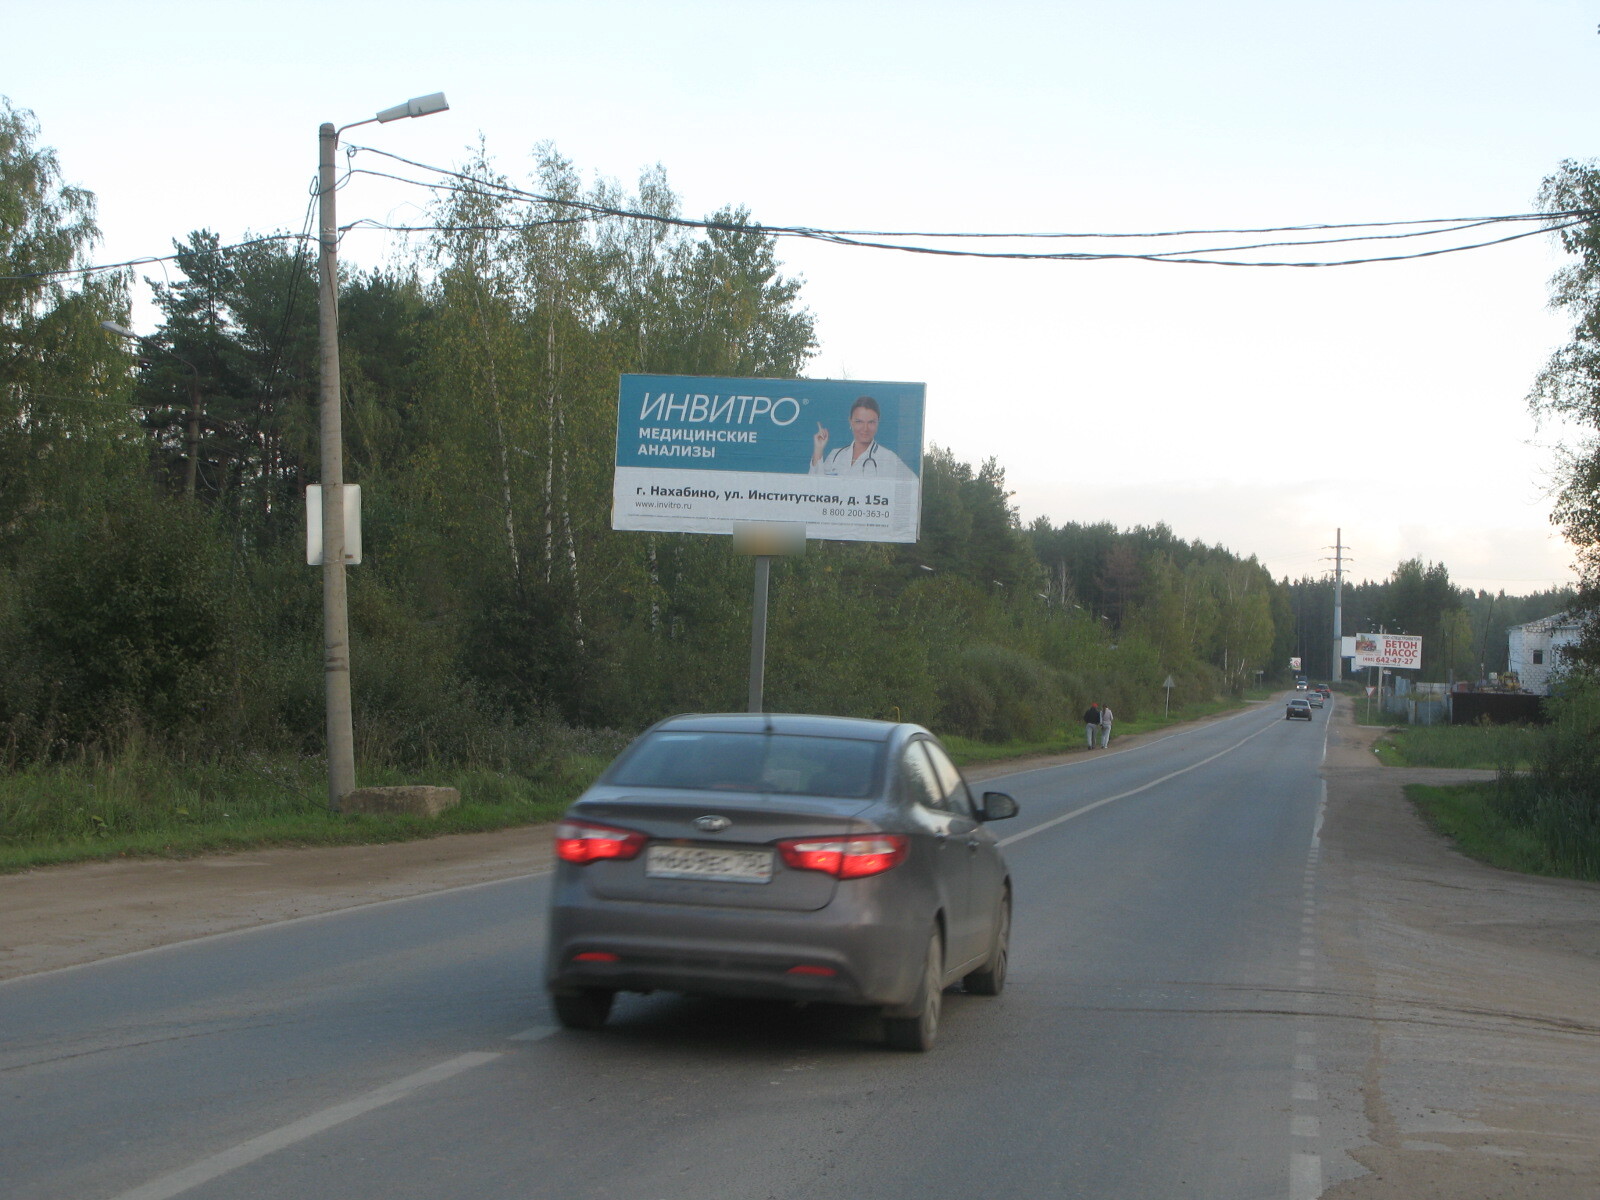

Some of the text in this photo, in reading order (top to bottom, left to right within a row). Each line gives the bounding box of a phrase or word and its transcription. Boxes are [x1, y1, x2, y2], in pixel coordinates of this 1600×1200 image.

[640, 393, 800, 426] ИНВИТРО
[639, 427, 757, 443] МЕДИЦИНСКИЕ
[638, 444, 715, 458] АНАЛИЗЫ
[636, 486, 889, 506] г. Нахабино, ул. Институтская, д. 15а
[635, 500, 692, 510] www.invitro.ru
[822, 508, 890, 519] 8 800 200-363-0
[1385, 640, 1418, 649] БЕТОН
[1384, 648, 1418, 657] НАСОС
